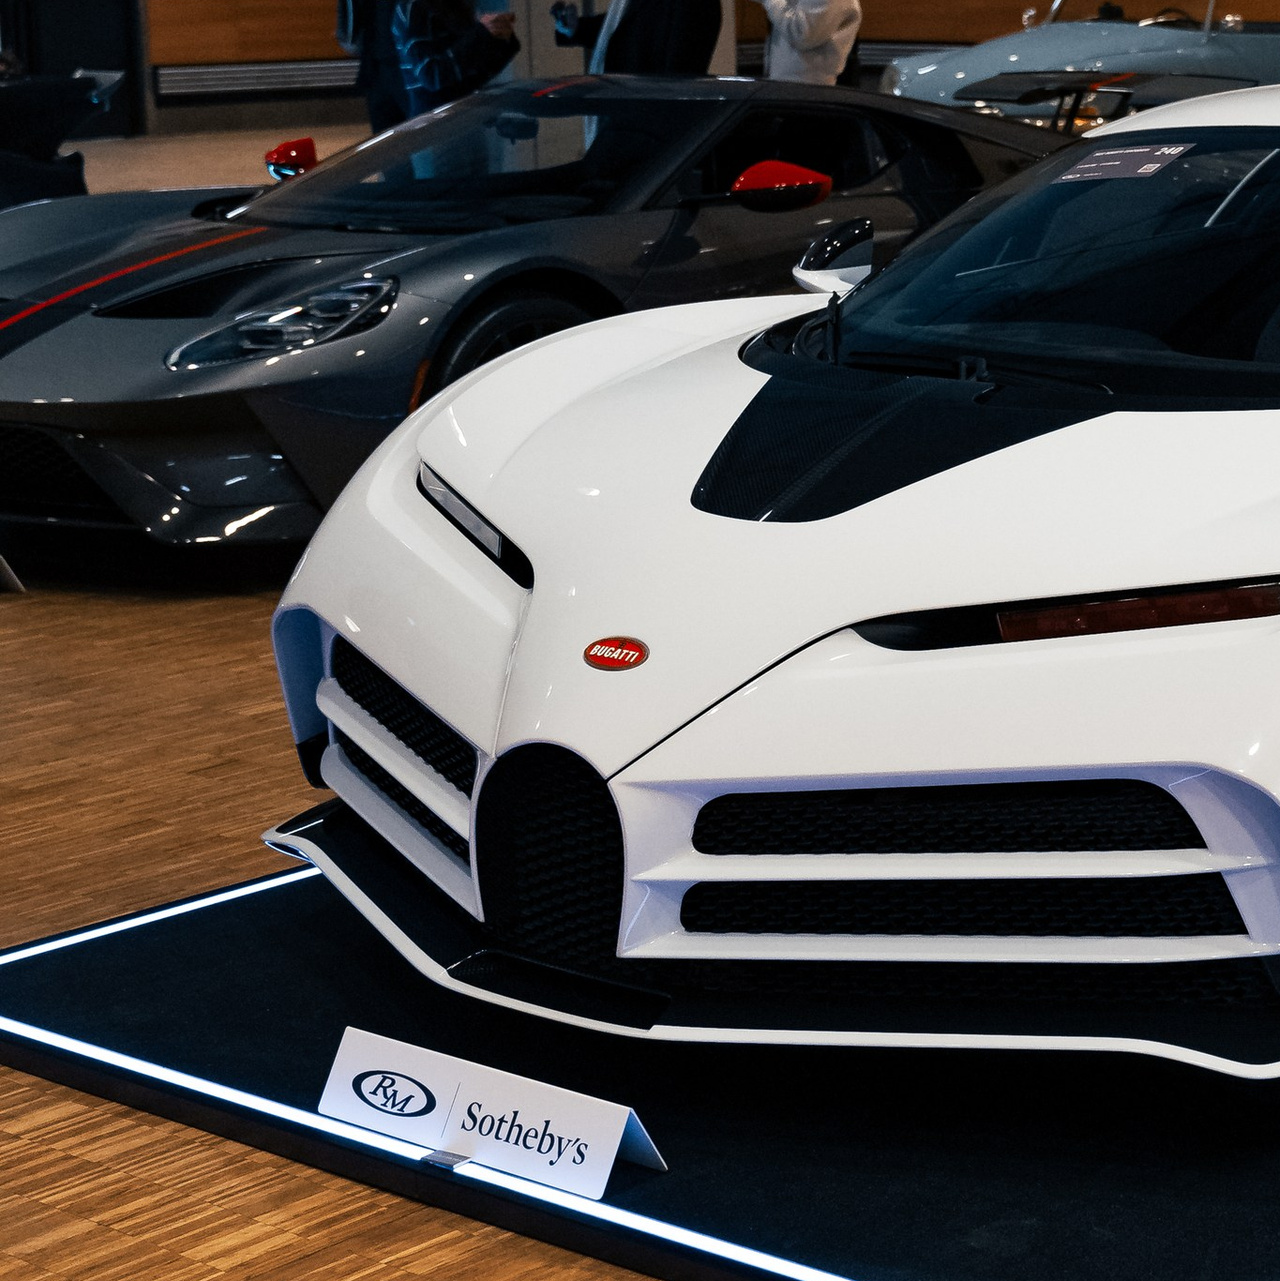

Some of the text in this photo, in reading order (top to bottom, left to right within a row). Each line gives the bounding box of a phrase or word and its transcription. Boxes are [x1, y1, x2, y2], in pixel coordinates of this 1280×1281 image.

[589, 645, 639, 662] BUGATTI
[368, 1074, 589, 1167] RM Sotheby's
